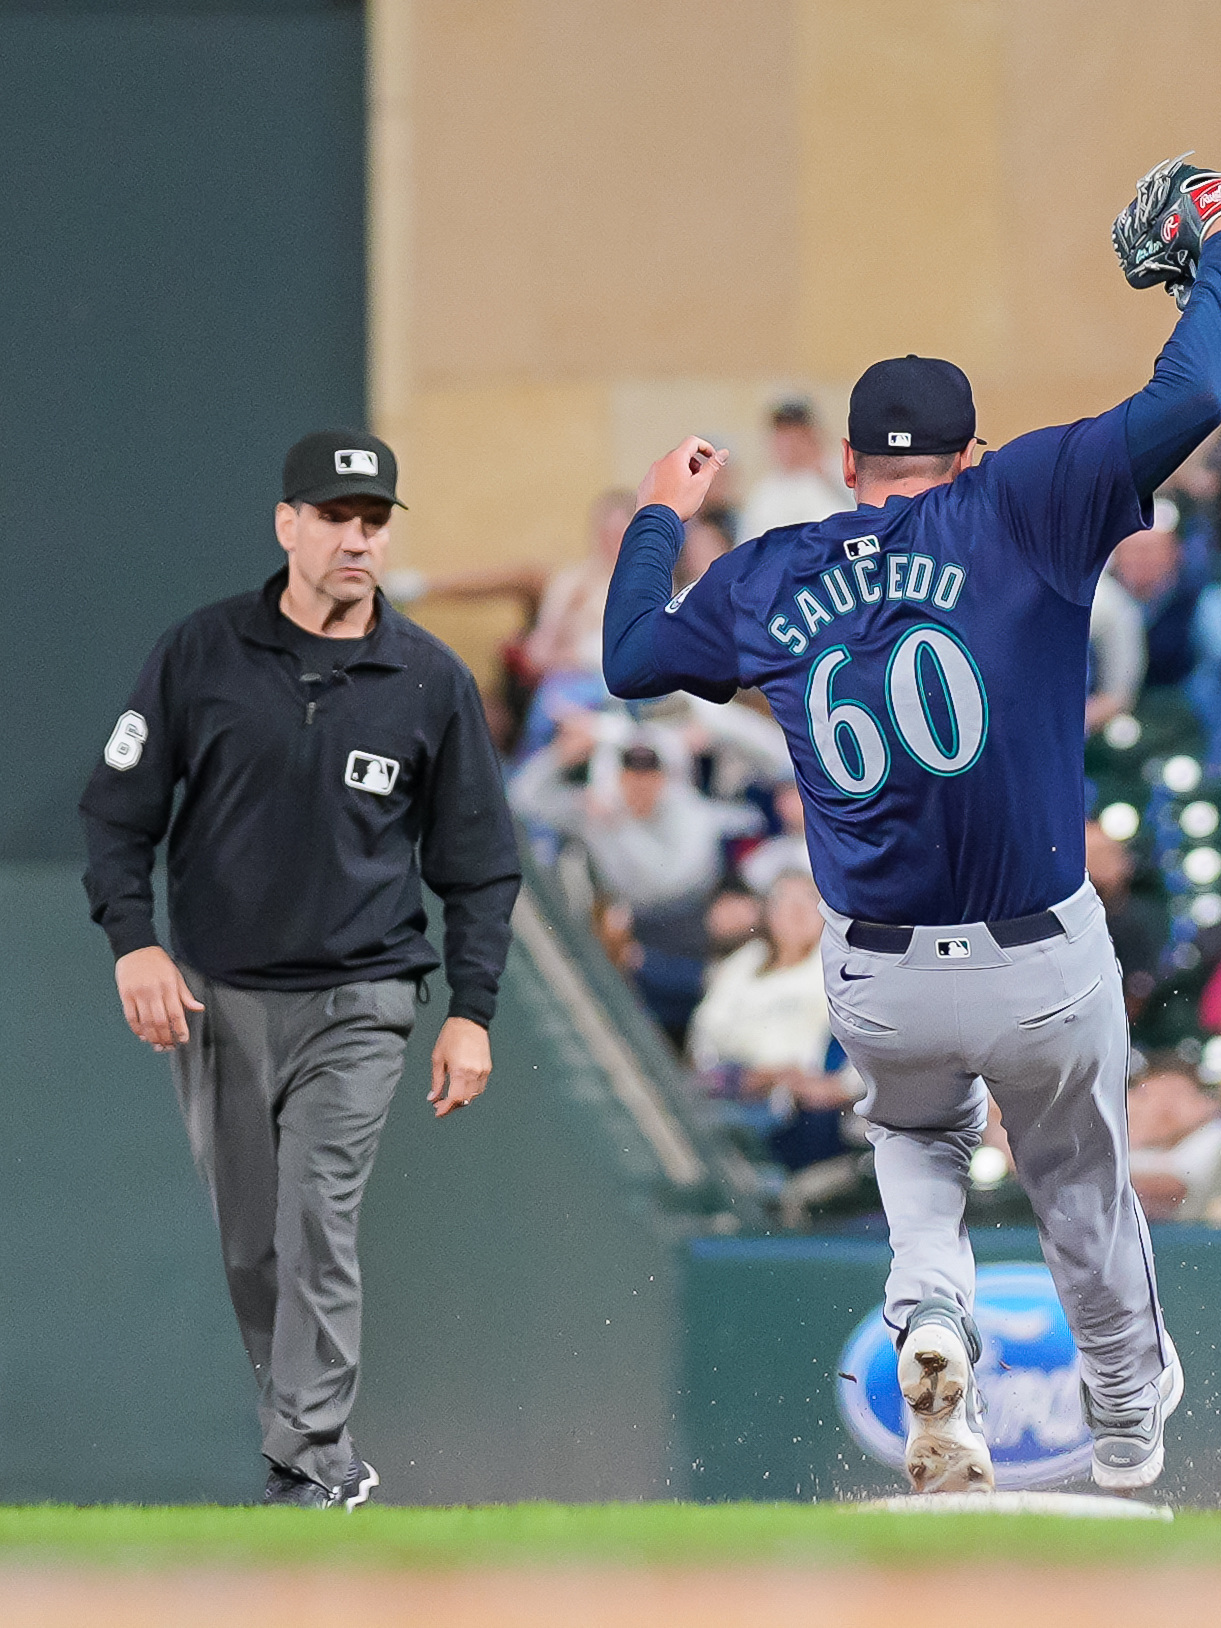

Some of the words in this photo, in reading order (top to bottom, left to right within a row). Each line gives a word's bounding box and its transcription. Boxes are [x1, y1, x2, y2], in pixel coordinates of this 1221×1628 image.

[768, 552, 966, 656] SAUCEDO
[104, 710, 148, 771] 6
[806, 623, 989, 798] 60
